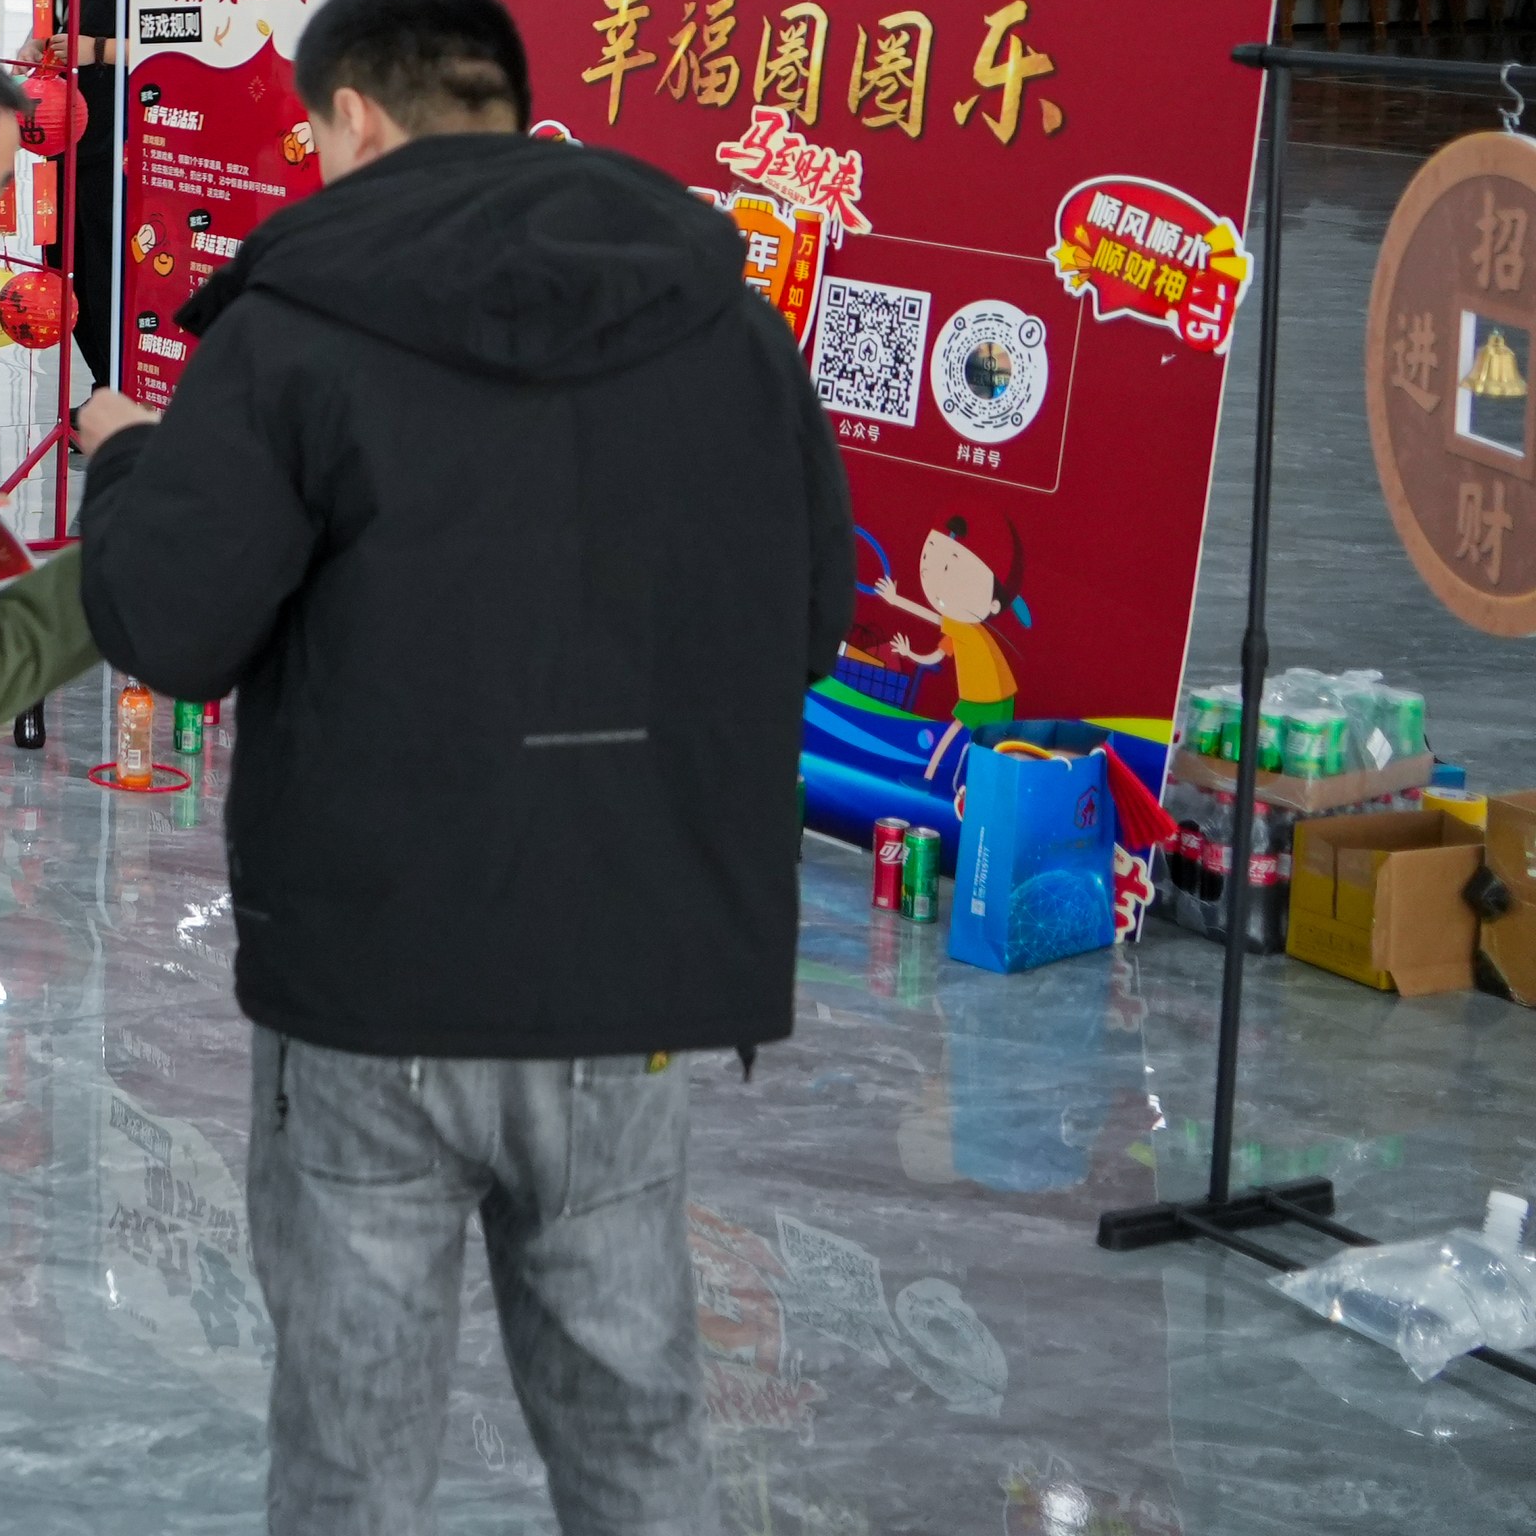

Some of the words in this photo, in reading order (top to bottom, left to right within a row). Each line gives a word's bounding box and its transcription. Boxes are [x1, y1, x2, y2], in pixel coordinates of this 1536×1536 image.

[140, 12, 200, 39] 游戏规则
[1086, 191, 1213, 270] 顺风顺水
[1471, 189, 1527, 292] 招
[1092, 236, 1188, 303] 顺财神
[1391, 311, 1442, 414] 进
[839, 419, 881, 442] 公众号
[956, 443, 1002, 468] 抖音号
[1456, 480, 1515, 585] 财
